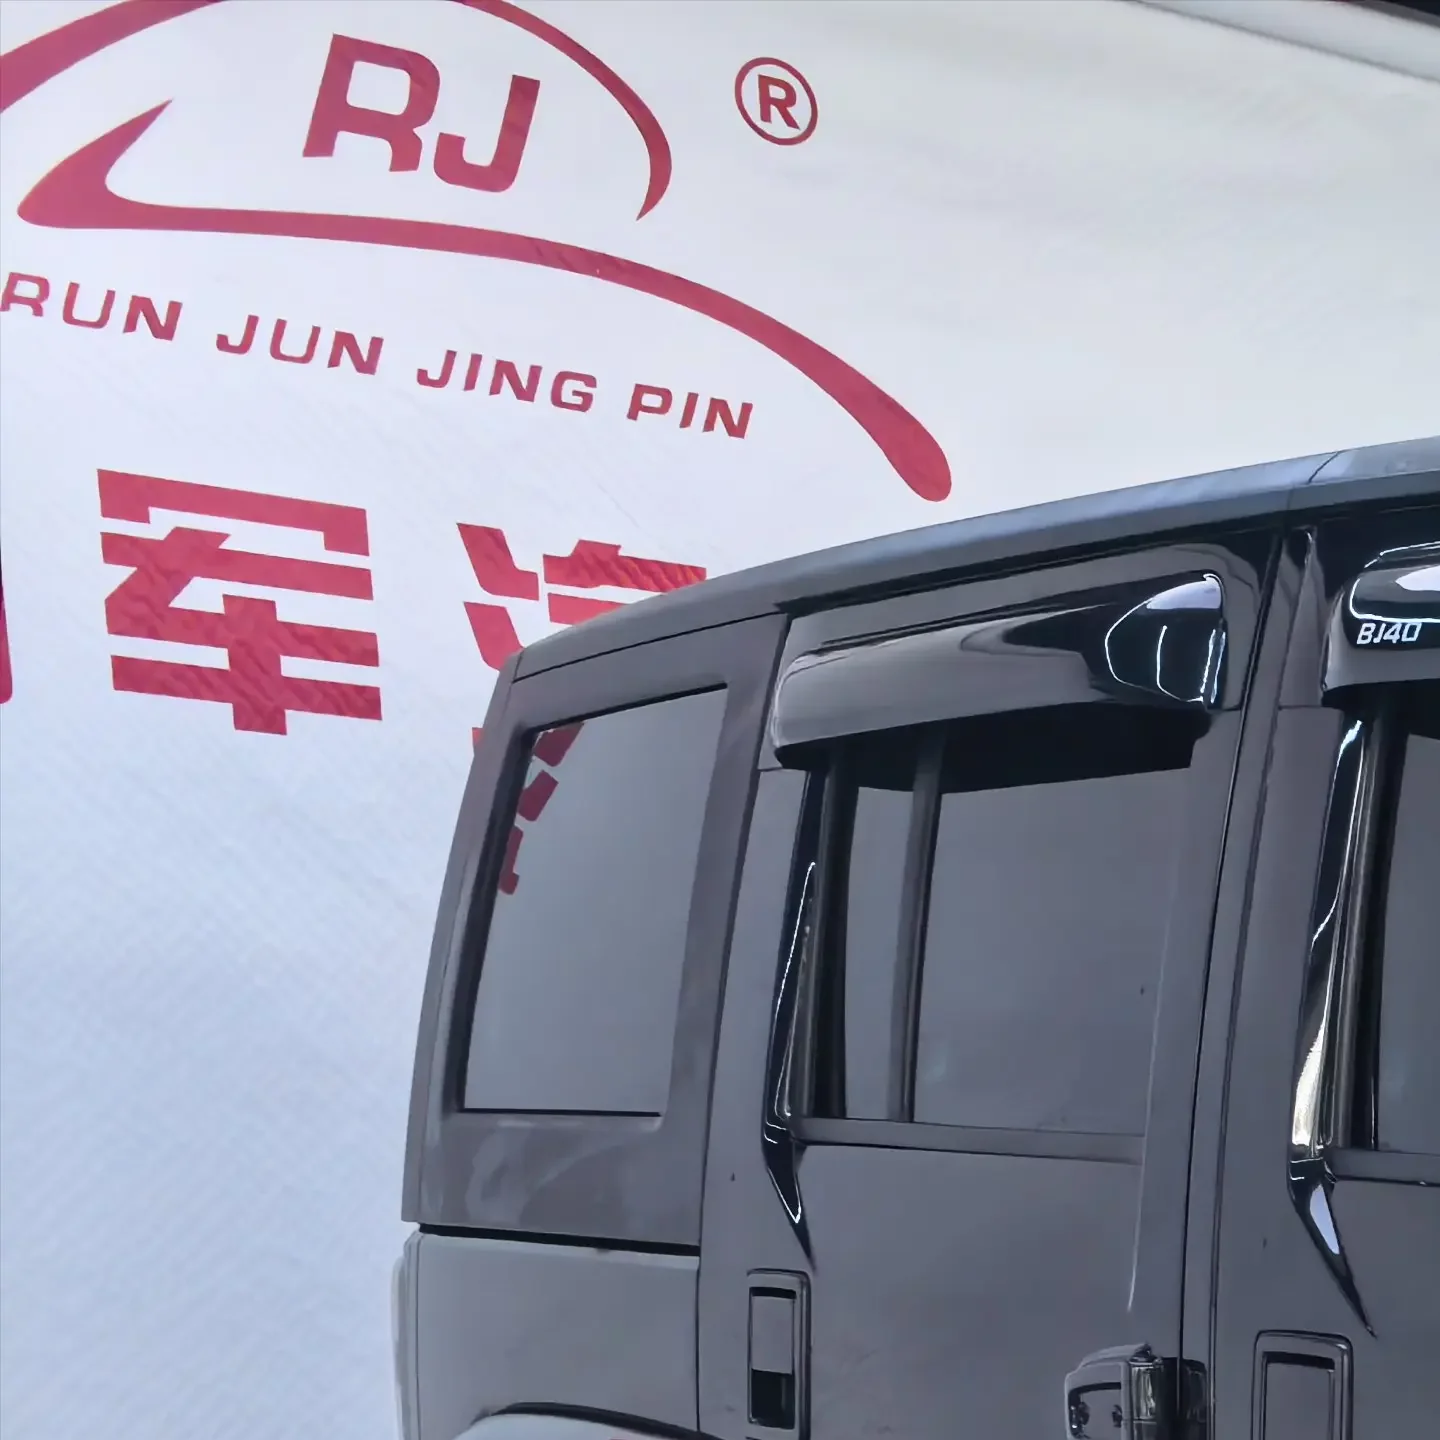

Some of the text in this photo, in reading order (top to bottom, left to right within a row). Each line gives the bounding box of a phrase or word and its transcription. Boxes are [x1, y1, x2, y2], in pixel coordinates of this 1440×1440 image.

[302, 33, 540, 193] RJ
[0, 272, 754, 439] RUN JUN JING PIN
[1356, 622, 1422, 645] BJ40
